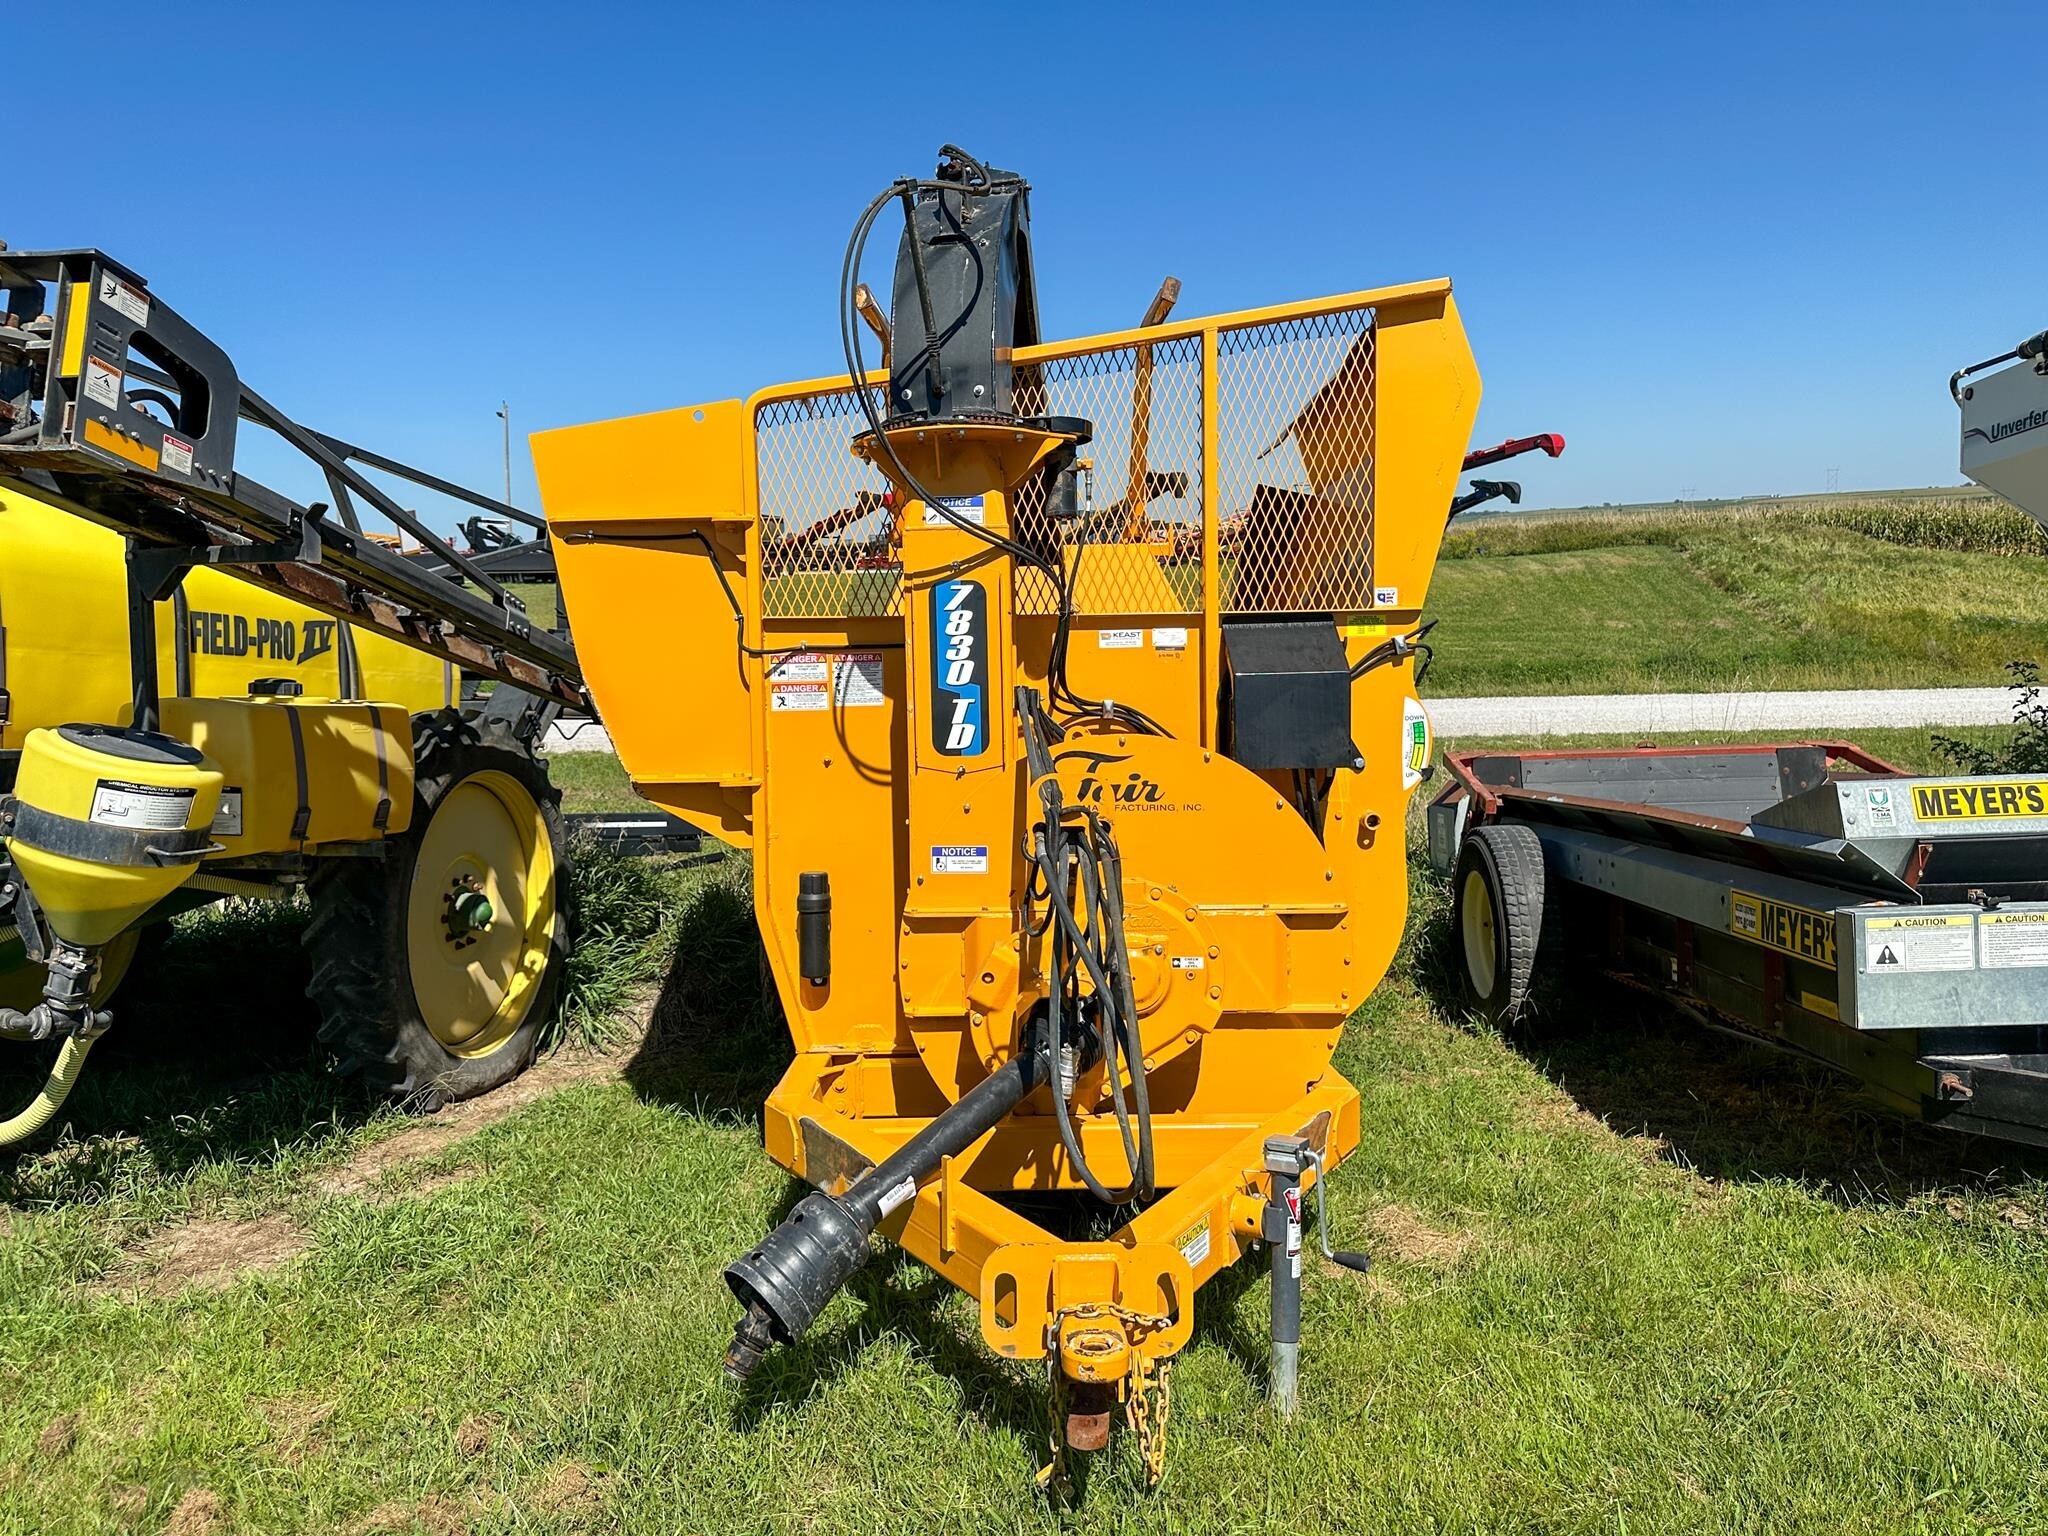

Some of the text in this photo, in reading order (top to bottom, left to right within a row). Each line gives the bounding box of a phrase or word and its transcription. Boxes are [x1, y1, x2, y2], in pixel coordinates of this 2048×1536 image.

[189, 611, 336, 665] FIELD-PRO IV
[779, 655, 818, 663] DANGER
[944, 584, 976, 750] 7830 TD
[108, 781, 139, 789] CHEMICAL
[1917, 785, 2045, 817] MEYER'S
[941, 847, 977, 856] NOTICE
[1905, 918, 1947, 927] CAUTION
[2005, 914, 2045, 923] CAUTION
[1182, 1221, 1204, 1246] CAUTION
